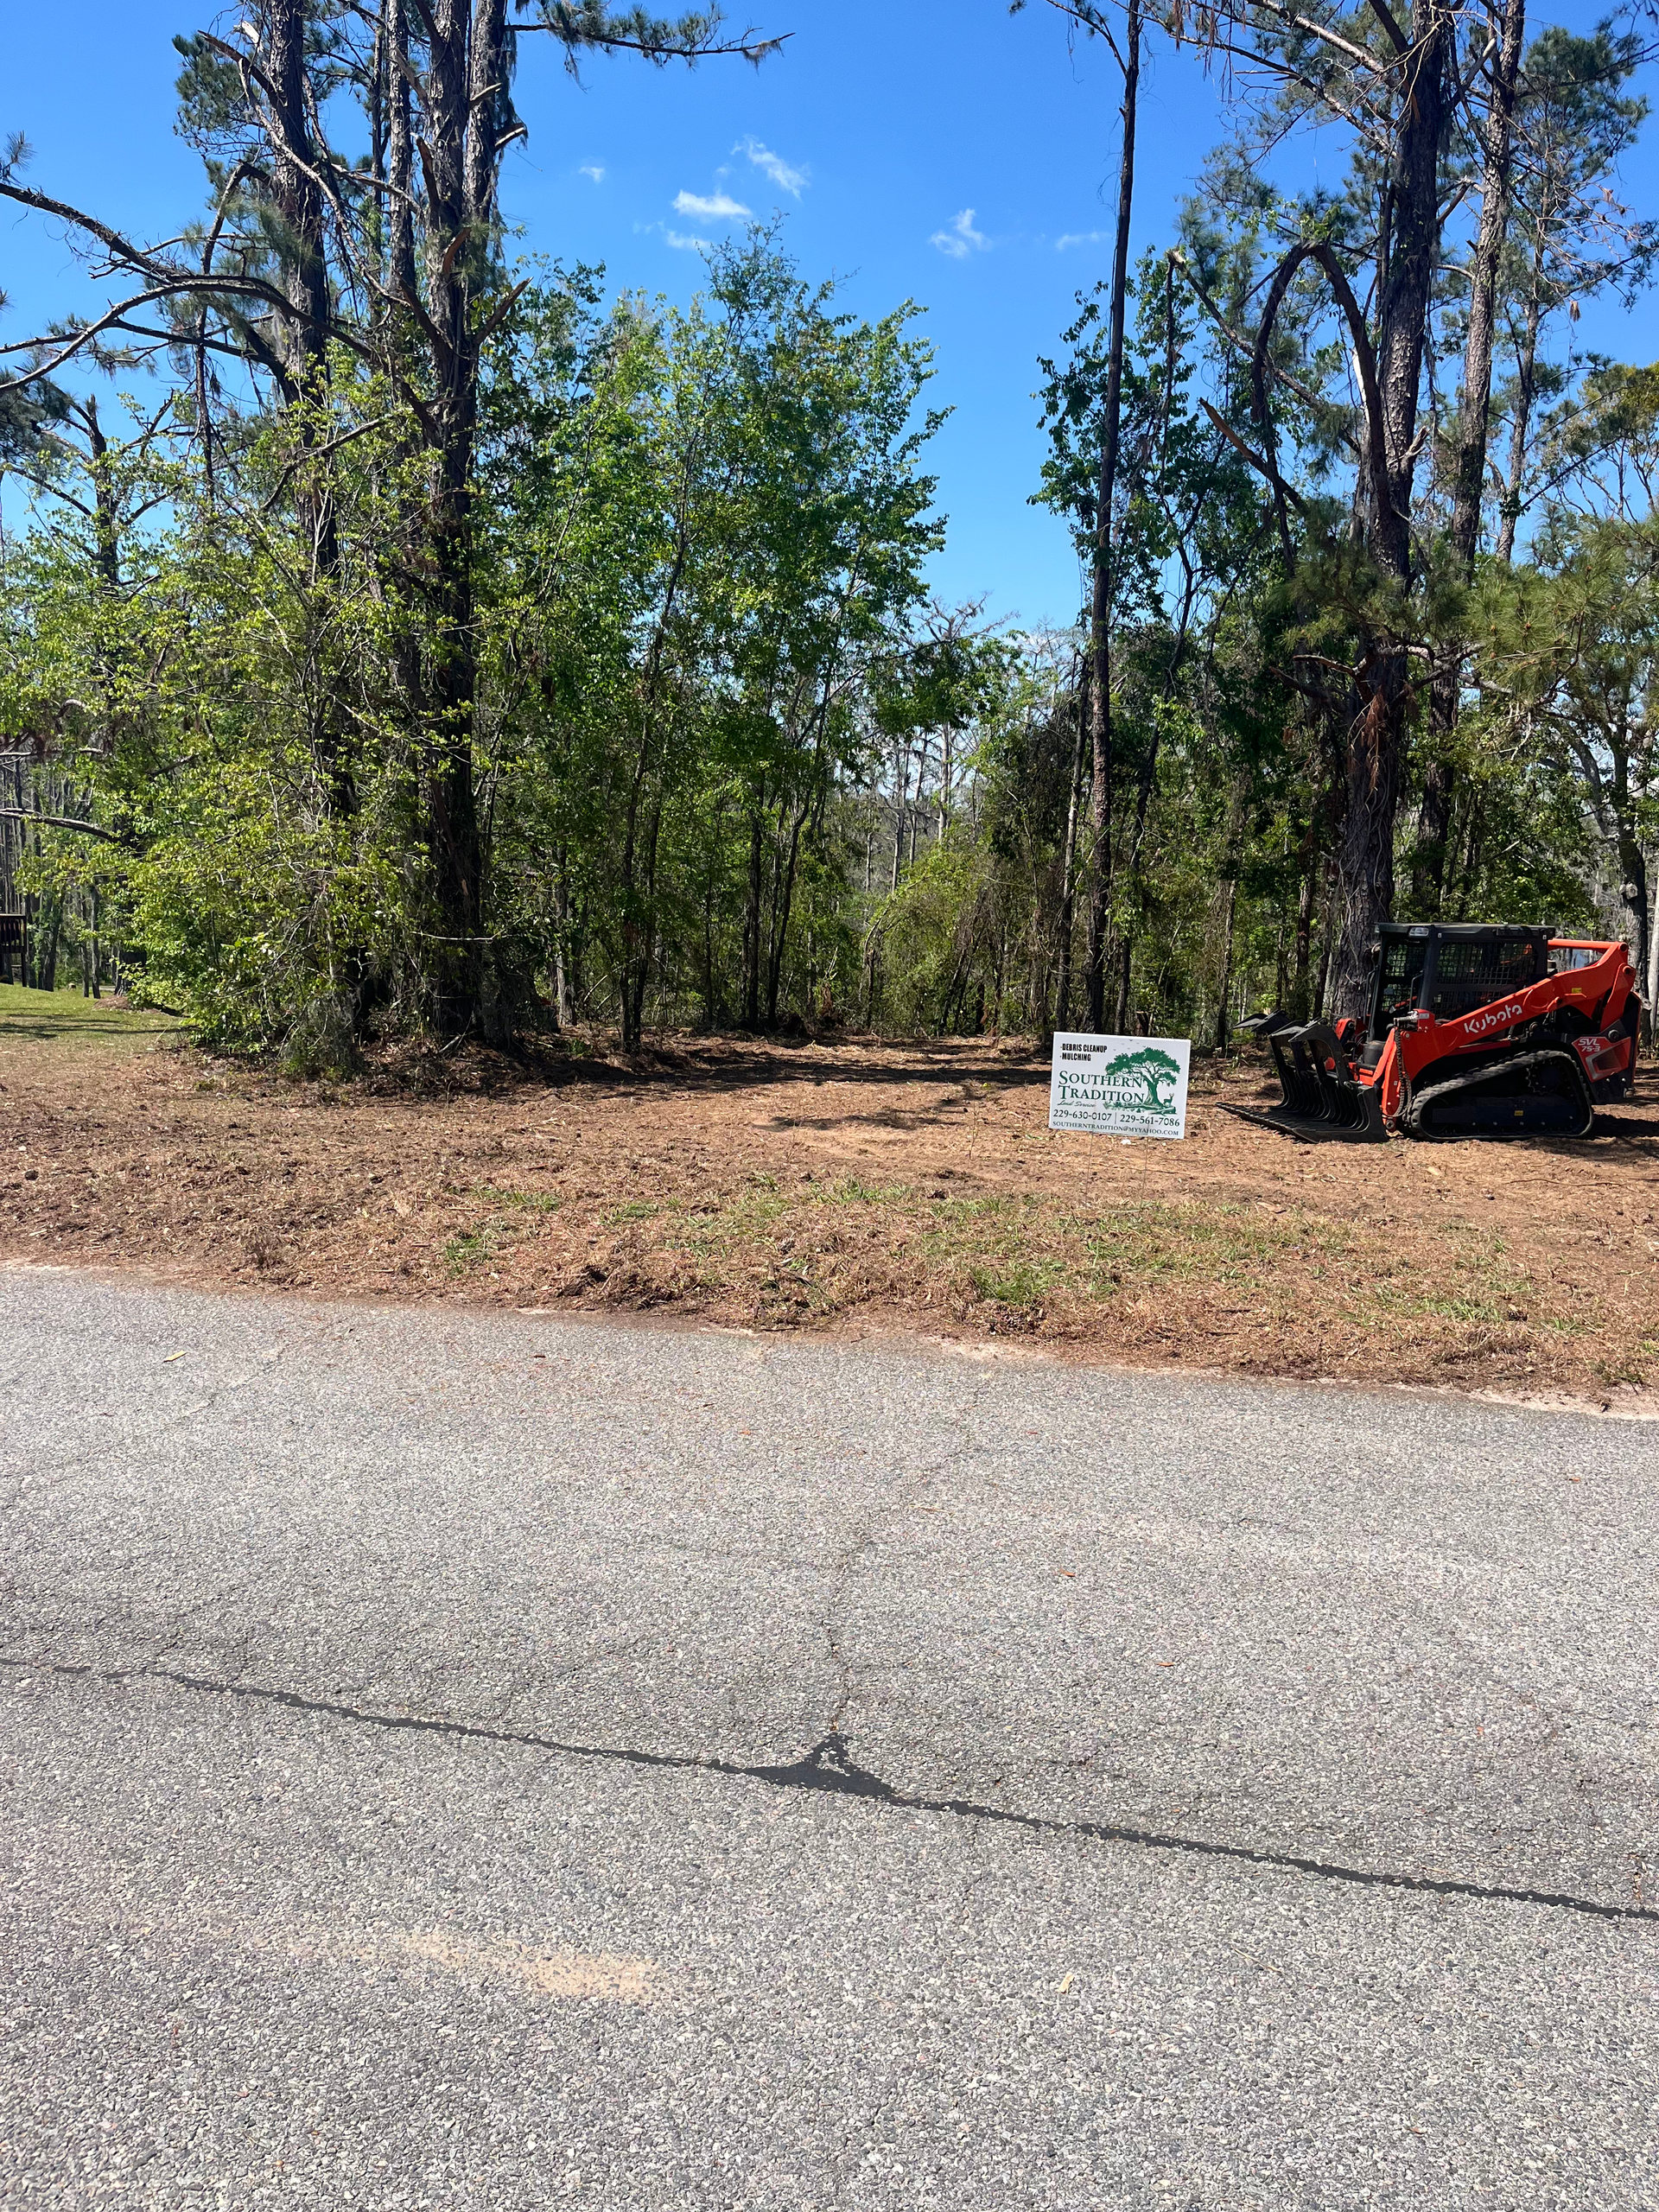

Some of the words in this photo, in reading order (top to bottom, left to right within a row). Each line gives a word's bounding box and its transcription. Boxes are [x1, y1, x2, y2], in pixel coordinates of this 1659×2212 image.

[1464, 1003, 1522, 1034] Kubota
[1083, 1044, 1108, 1053] CLEANUP
[1578, 1037, 1600, 1046] SVL
[1059, 1052, 1091, 1061] -MULCHING
[1058, 1071, 1144, 1089] SOUTHERN
[1058, 1084, 1145, 1103] TRADITION
[1052, 1109, 1112, 1122] 229-630-0107
[1120, 1114, 1180, 1127] 229-561-7086
[1052, 1121, 1179, 1136] SOUTHERNTRADITION@MYYAHOO.COM
